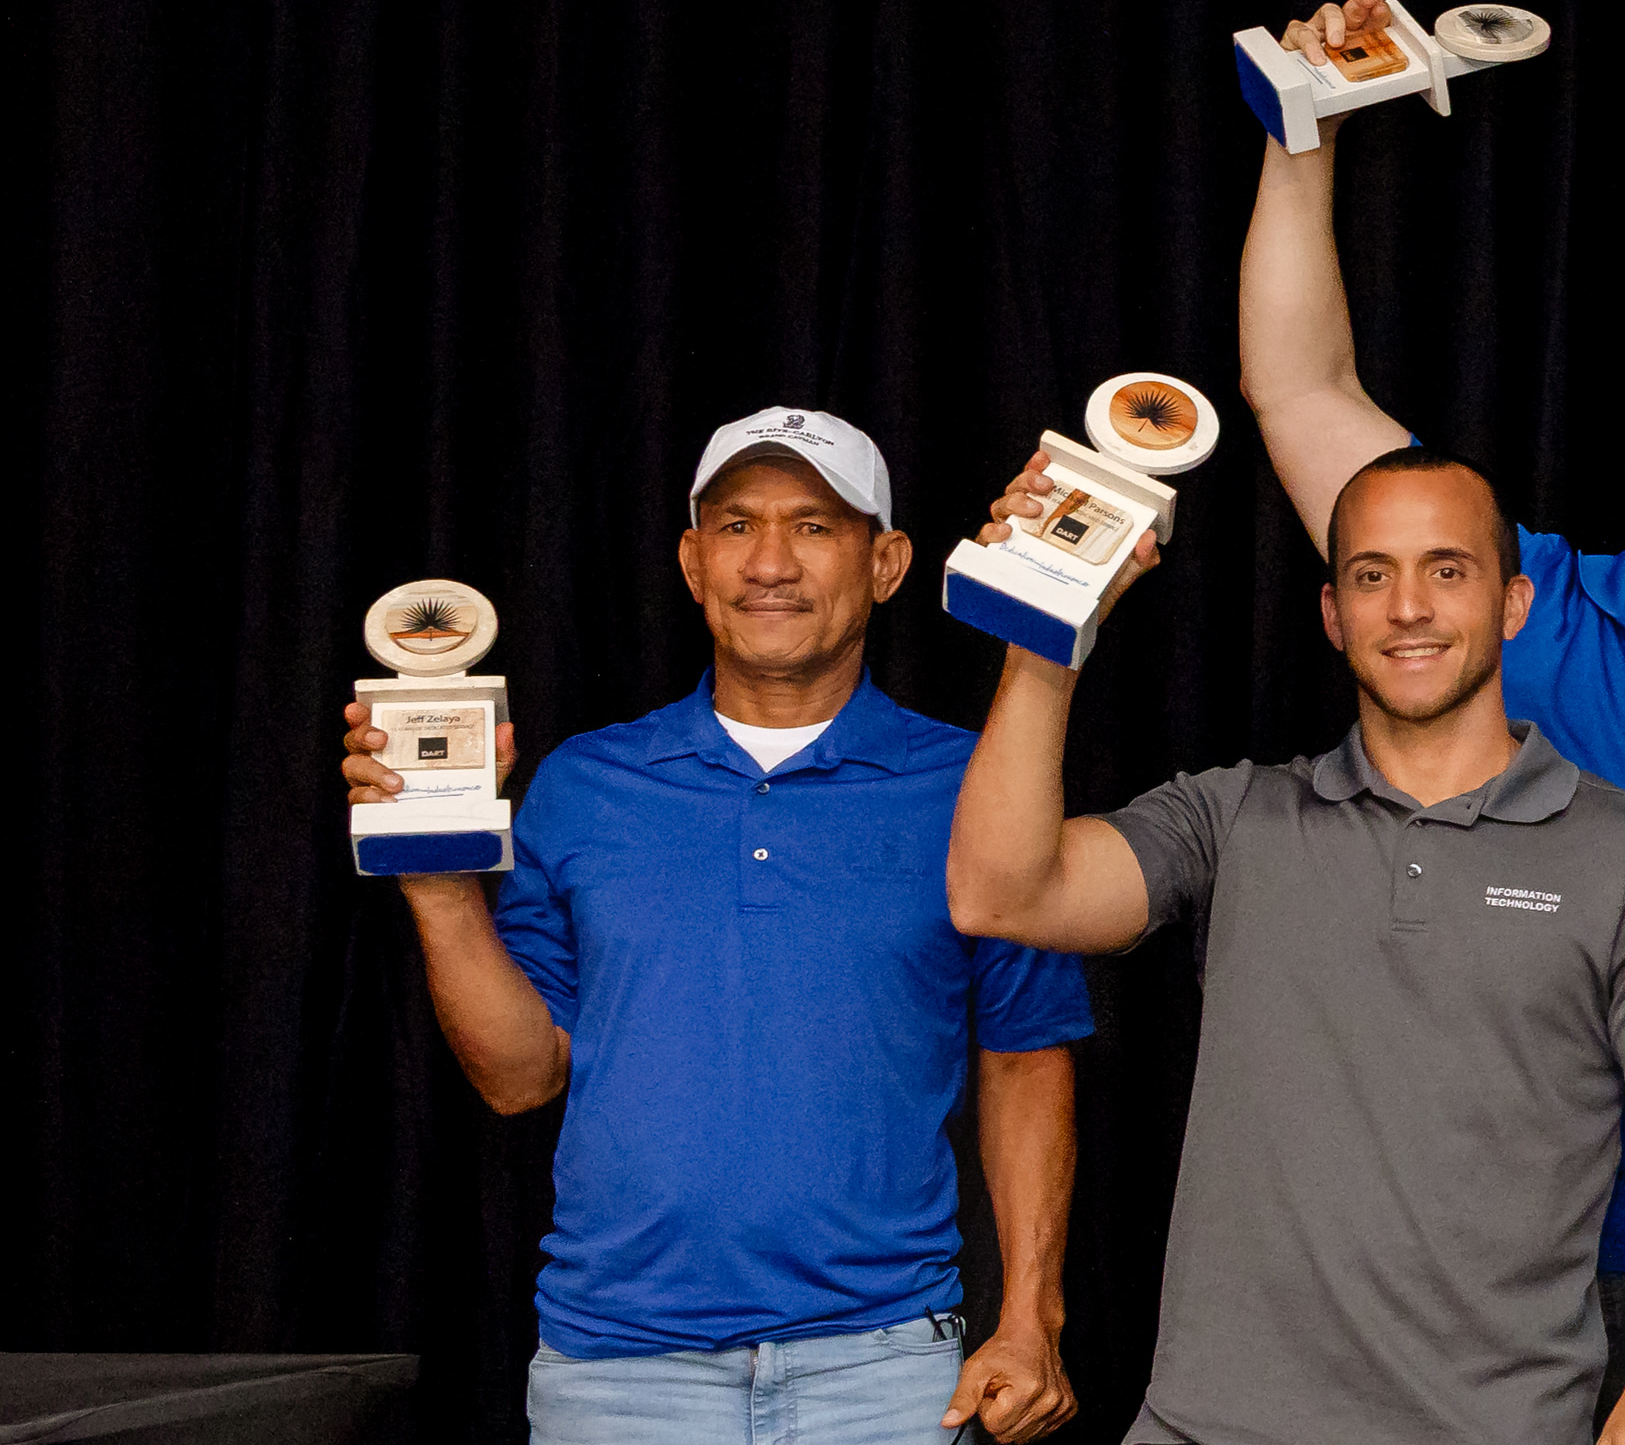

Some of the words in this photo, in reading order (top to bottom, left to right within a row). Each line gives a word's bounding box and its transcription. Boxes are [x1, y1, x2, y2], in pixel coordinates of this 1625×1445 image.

[1089, 500, 1126, 525] Parsons
[1055, 527, 1080, 541] DART
[406, 715, 424, 724] Jeff
[426, 715, 461, 725] Zelaya
[420, 749, 446, 757] DART
[1486, 886, 1562, 903] INFORMATION
[1485, 897, 1560, 913] TECHNOLOGY
